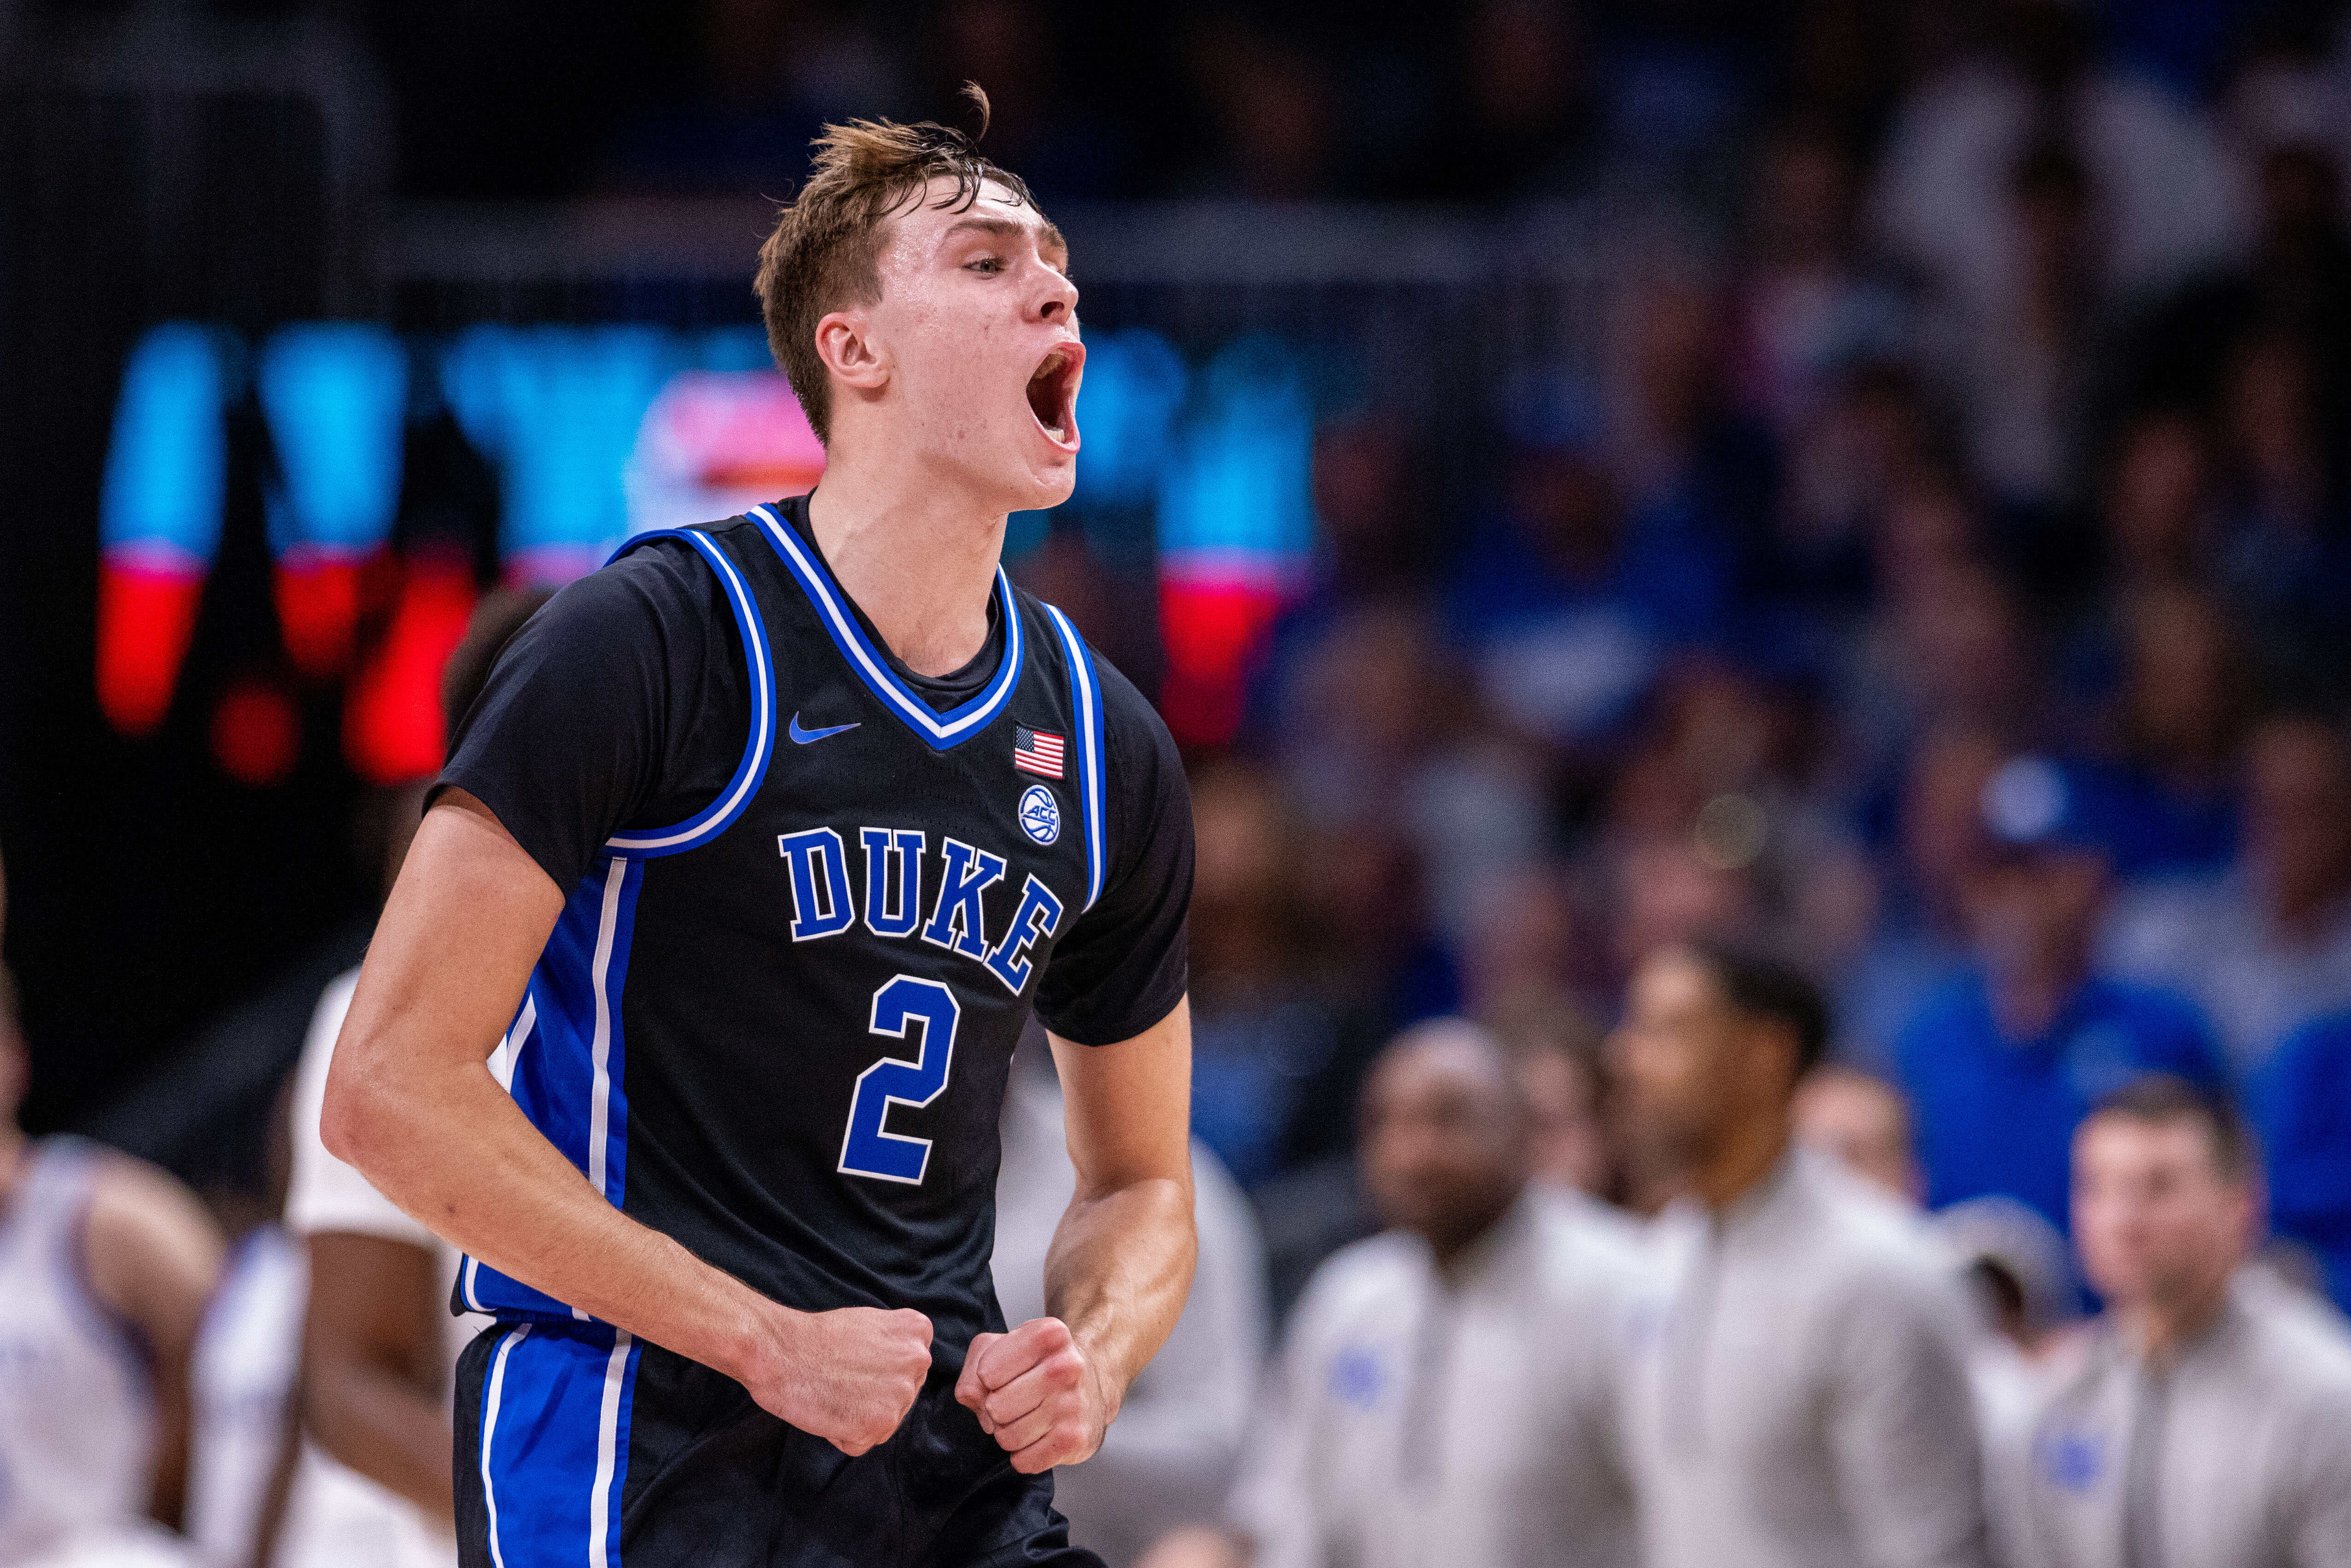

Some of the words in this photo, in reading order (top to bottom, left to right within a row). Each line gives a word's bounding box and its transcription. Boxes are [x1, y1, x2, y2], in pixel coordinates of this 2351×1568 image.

[1027, 805, 1056, 822] ACC
[778, 827, 1063, 997] DUKE
[837, 973, 961, 1185] 2
